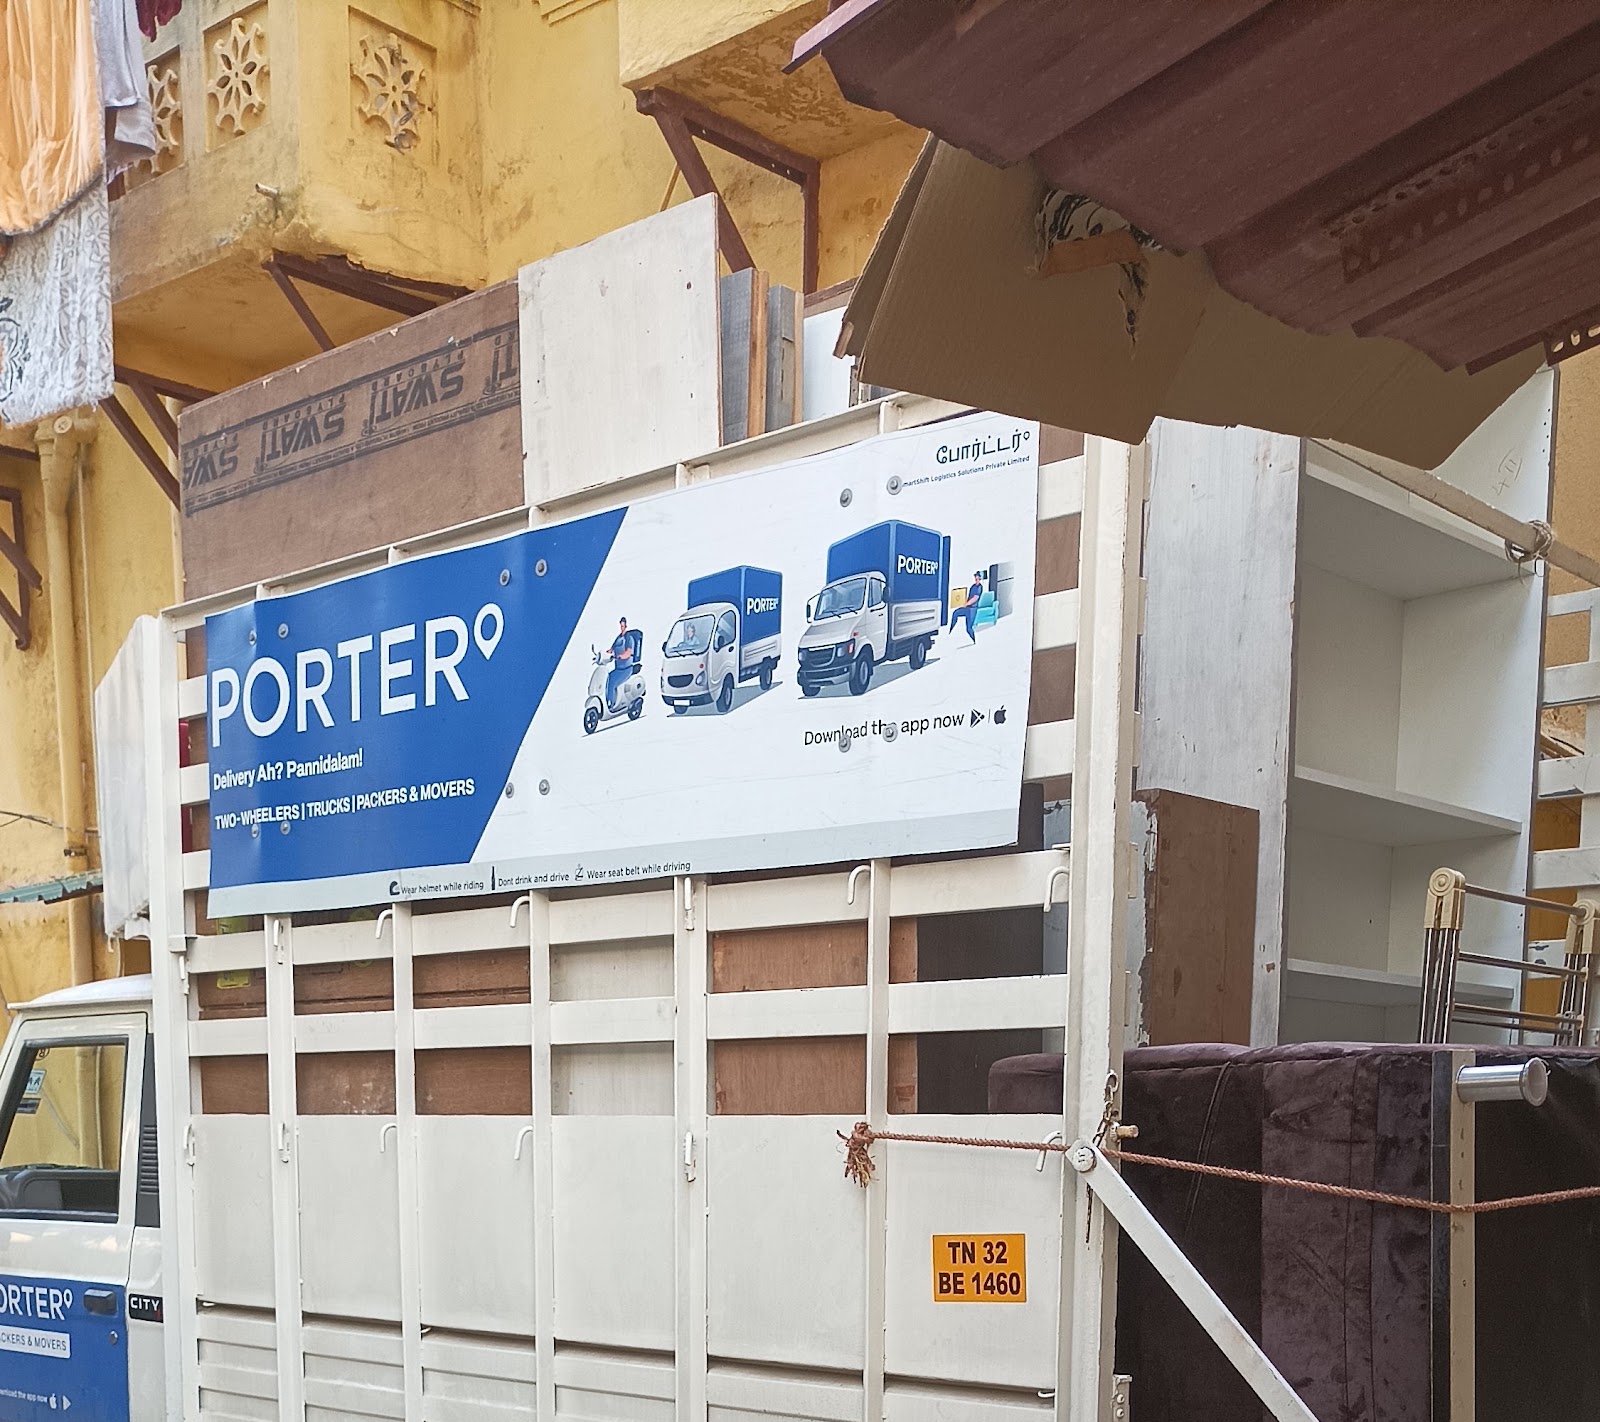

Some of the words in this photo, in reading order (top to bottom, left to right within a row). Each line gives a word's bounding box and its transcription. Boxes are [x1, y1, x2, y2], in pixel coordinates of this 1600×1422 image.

[369, 361, 466, 434] SWATI
[259, 404, 347, 470] SWATI
[936, 428, 1022, 464] போர்ட்டர்
[902, 476, 930, 488] martShift
[931, 471, 957, 482] Logistics
[957, 465, 984, 477] Solutions
[985, 460, 1006, 470] Private
[1007, 455, 1030, 466] Limited
[897, 554, 936, 575] PORTER
[746, 597, 777, 616] PORTER
[211, 614, 470, 748] PORTER
[901, 717, 930, 735] app
[933, 713, 965, 730] now
[213, 767, 256, 791] Delivery
[257, 762, 283, 783] Ah?
[286, 748, 364, 779] Pannidalam!
[214, 803, 300, 831] TWO-WHEELERS
[308, 797, 351, 819] TRUCKS
[357, 787, 408, 811] PACKERS
[408, 785, 419, 802] &
[420, 778, 476, 801] MOVERS
[498, 876, 513, 888] Dont
[515, 874, 533, 886] drink
[534, 873, 548, 884] and
[549, 871, 570, 883] drive
[587, 868, 607, 880] Wear
[608, 867, 624, 879] seat
[625, 865, 640, 877] belt
[642, 862, 662, 875] while
[663, 860, 692, 875] driving
[401, 884, 418, 896] Wear
[418, 881, 442, 894] helmet
[443, 880, 462, 892] while
[463, 879, 484, 893] riding
[947, 1241, 976, 1264] TN
[982, 1241, 1008, 1264] 32
[938, 1272, 965, 1295] BE
[971, 1272, 1021, 1295] 1460
[130, 1297, 160, 1311] CITY
[27, 1336, 32, 1346] &
[34, 1337, 67, 1351] MOVERS
